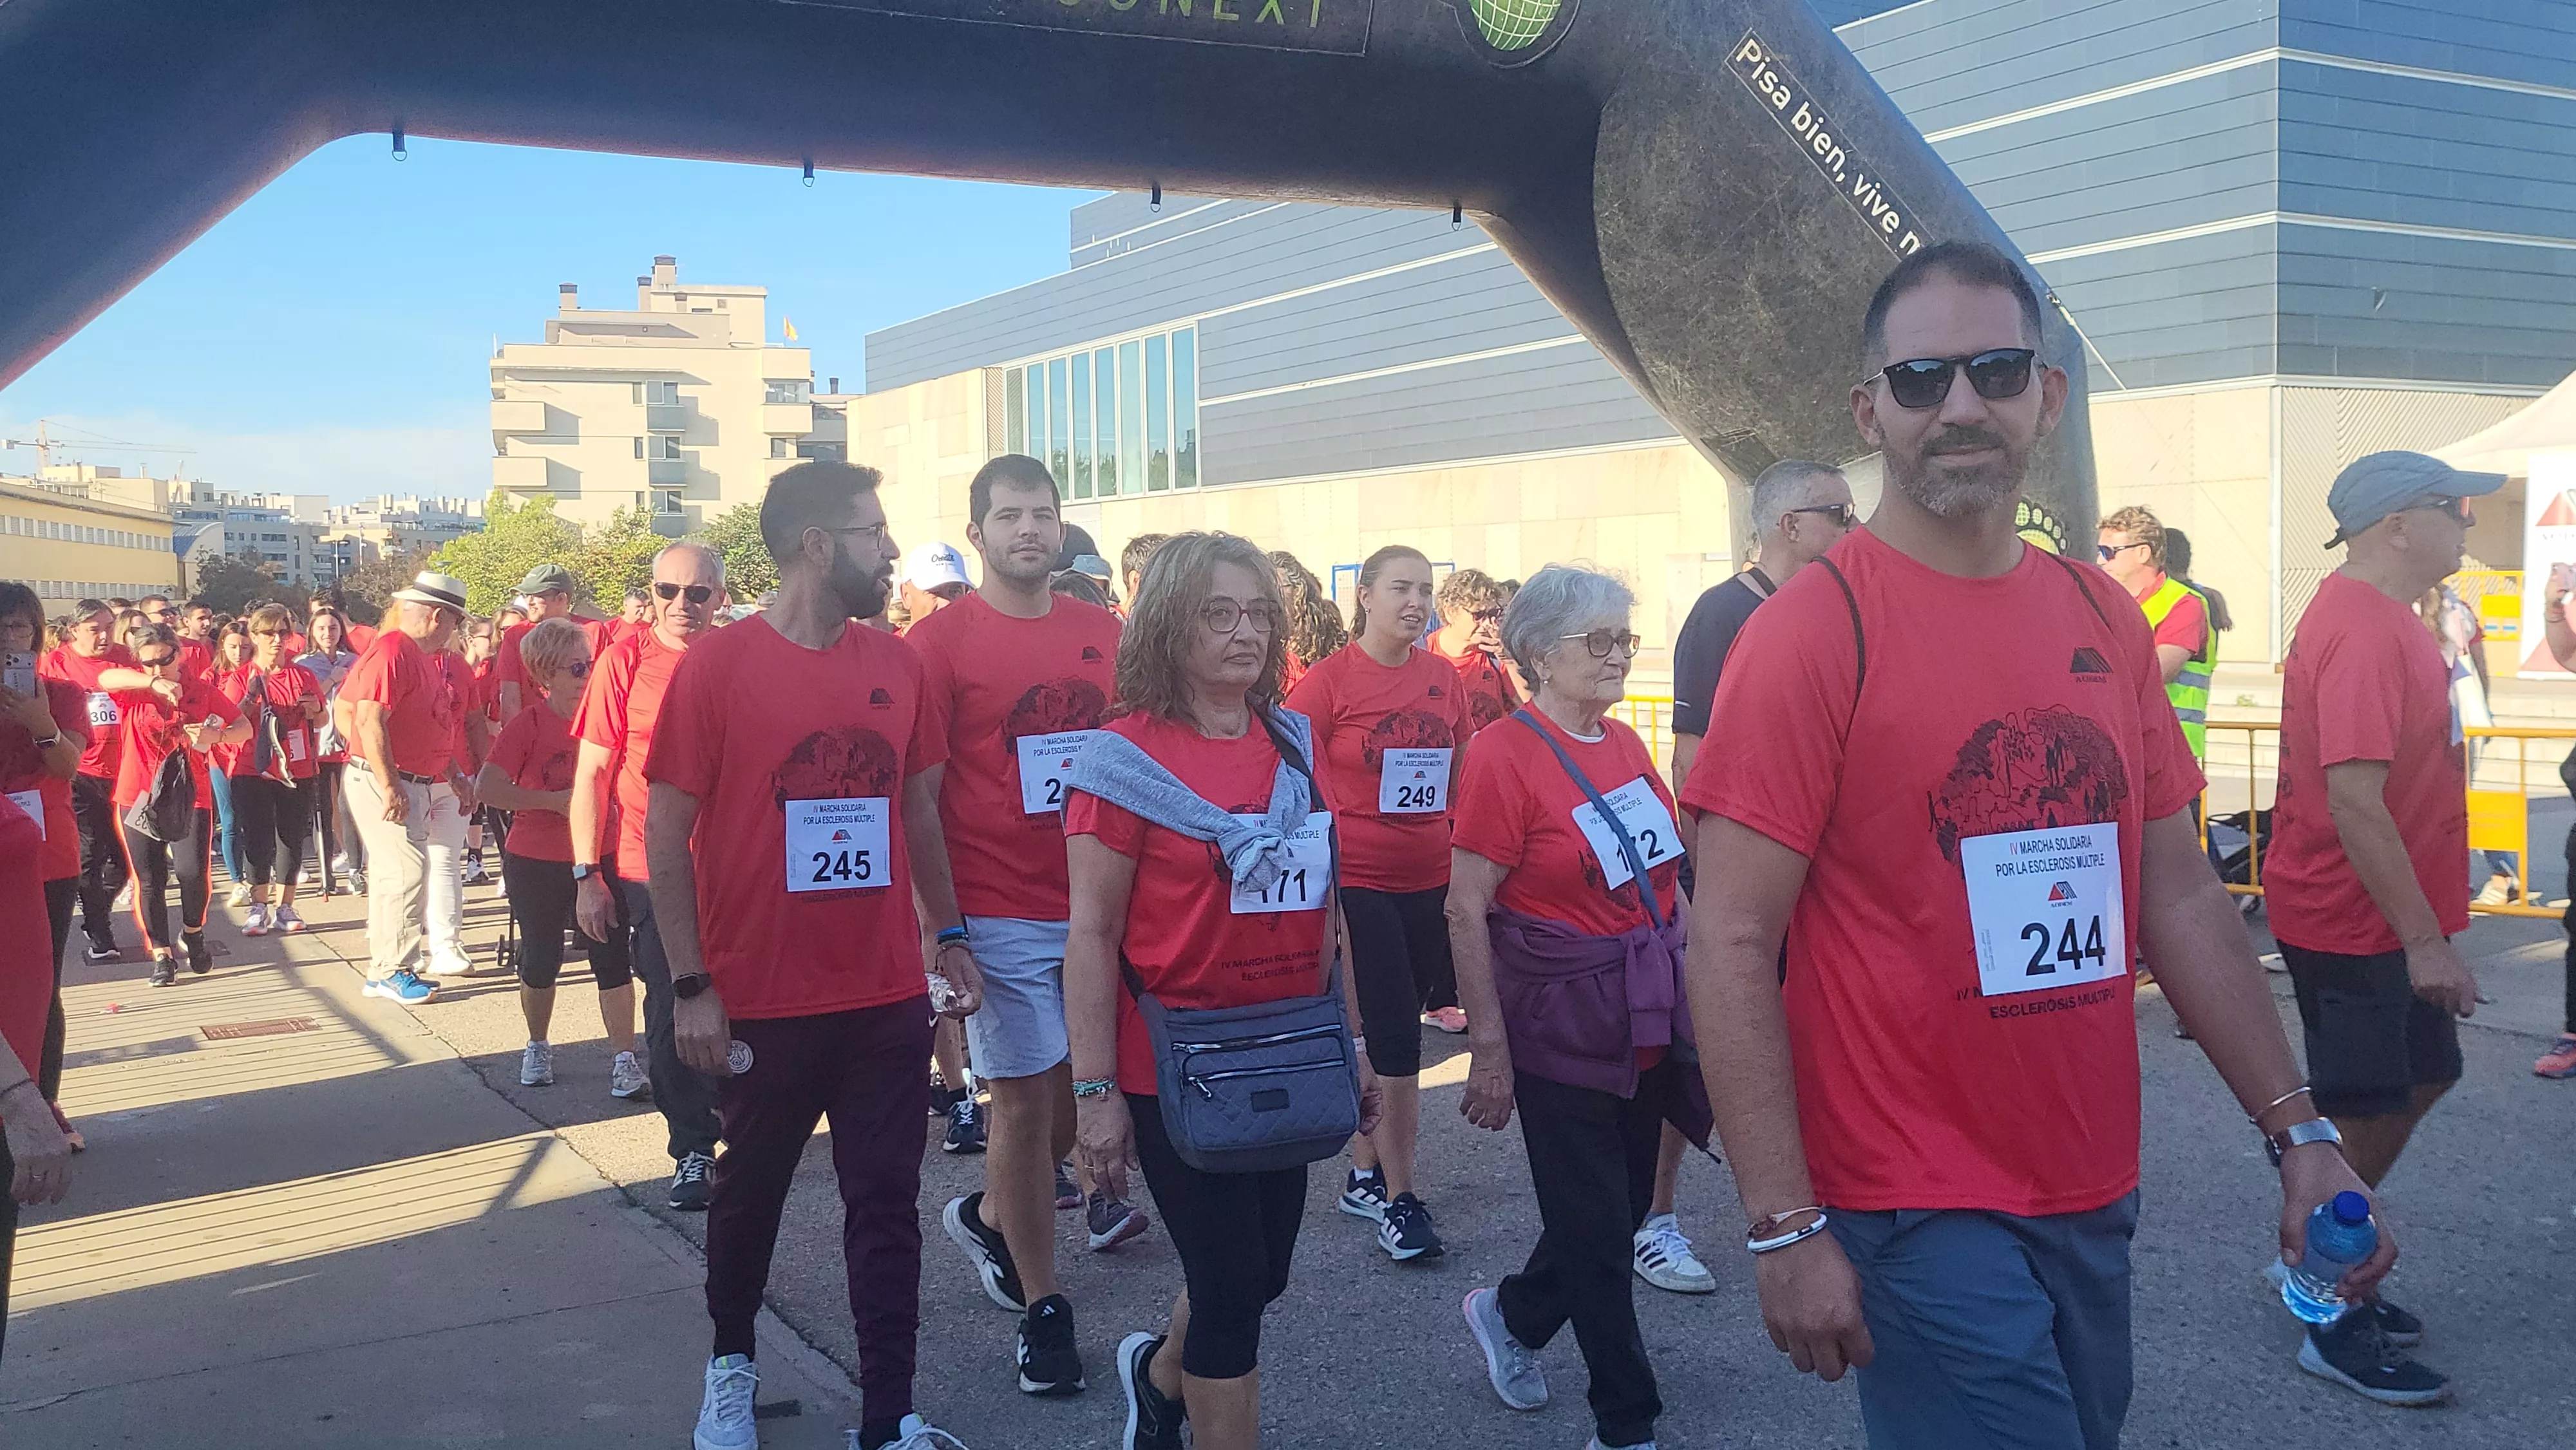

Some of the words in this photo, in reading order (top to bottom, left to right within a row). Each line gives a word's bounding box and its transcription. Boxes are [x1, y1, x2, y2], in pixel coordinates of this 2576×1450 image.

[1736, 38, 1792, 110] Pisa
[1791, 101, 1847, 182] bien,
[1853, 173, 1900, 232] vive
[90, 710, 117, 722] 306
[841, 803, 867, 811] SOLIDARIA
[1397, 786, 1435, 807] 249
[803, 816, 815, 825] POR
[815, 816, 822, 824] LA
[822, 814, 853, 824] ESCLEROSIS
[1616, 829, 1665, 872] 12
[2010, 842, 2019, 855] IV
[2020, 838, 2055, 855] MARCHA
[2056, 835, 2093, 851] SOLIDARIA
[812, 850, 871, 883] 245
[1996, 862, 2016, 877] POR
[2016, 860, 2029, 875] LA
[2028, 856, 2076, 874] ESCLEROSIS
[2021, 915, 2106, 976] 244
[1990, 997, 2077, 1019] ESCLEROSIS
